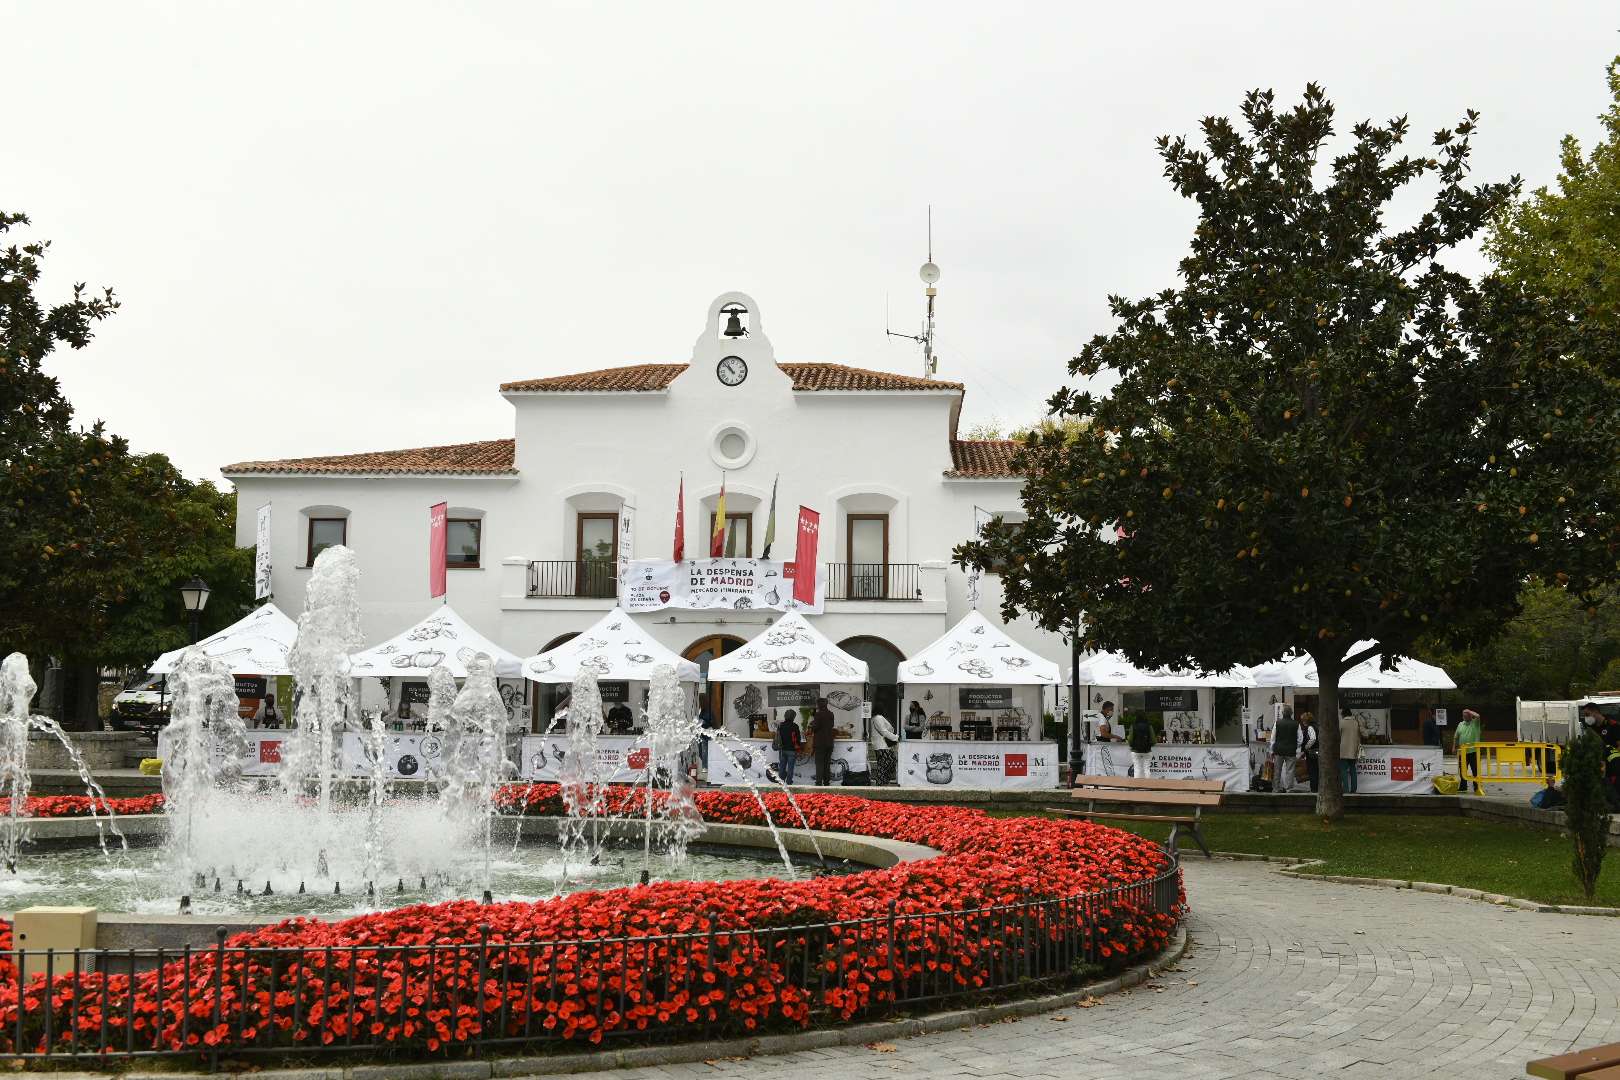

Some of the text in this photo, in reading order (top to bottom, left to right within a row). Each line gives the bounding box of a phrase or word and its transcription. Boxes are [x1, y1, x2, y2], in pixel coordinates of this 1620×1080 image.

[690, 568, 754, 577] LA DESPENSA
[690, 576, 754, 587] DE MADRID
[720, 587, 754, 595] ITINERANTE
[1161, 761, 1192, 769] MADRID
